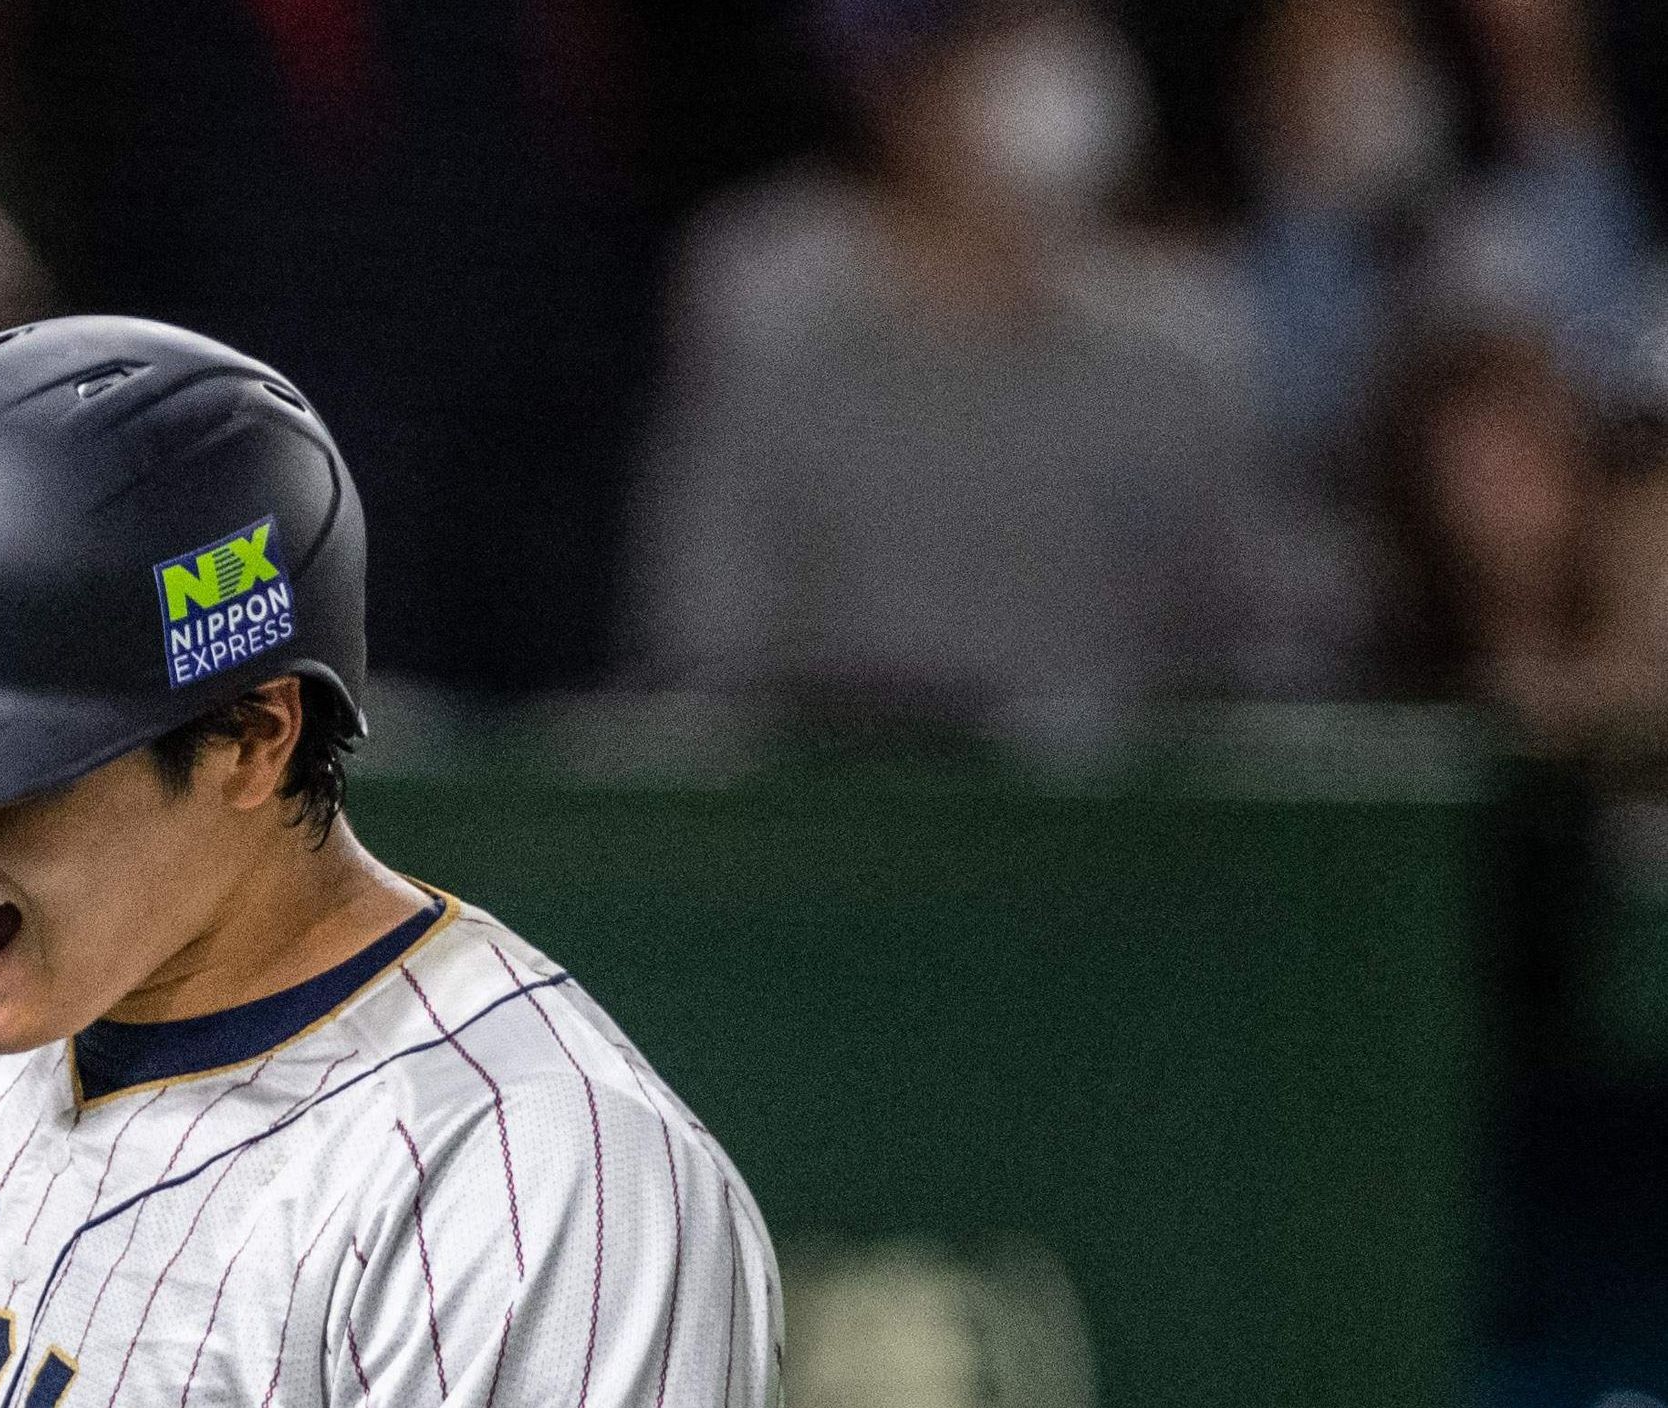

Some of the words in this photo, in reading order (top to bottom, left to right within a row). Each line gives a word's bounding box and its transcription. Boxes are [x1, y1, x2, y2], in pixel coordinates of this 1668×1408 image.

[161, 522, 280, 622] NX
[170, 582, 291, 655] NIPPON
[173, 612, 293, 684] EXPRESS
